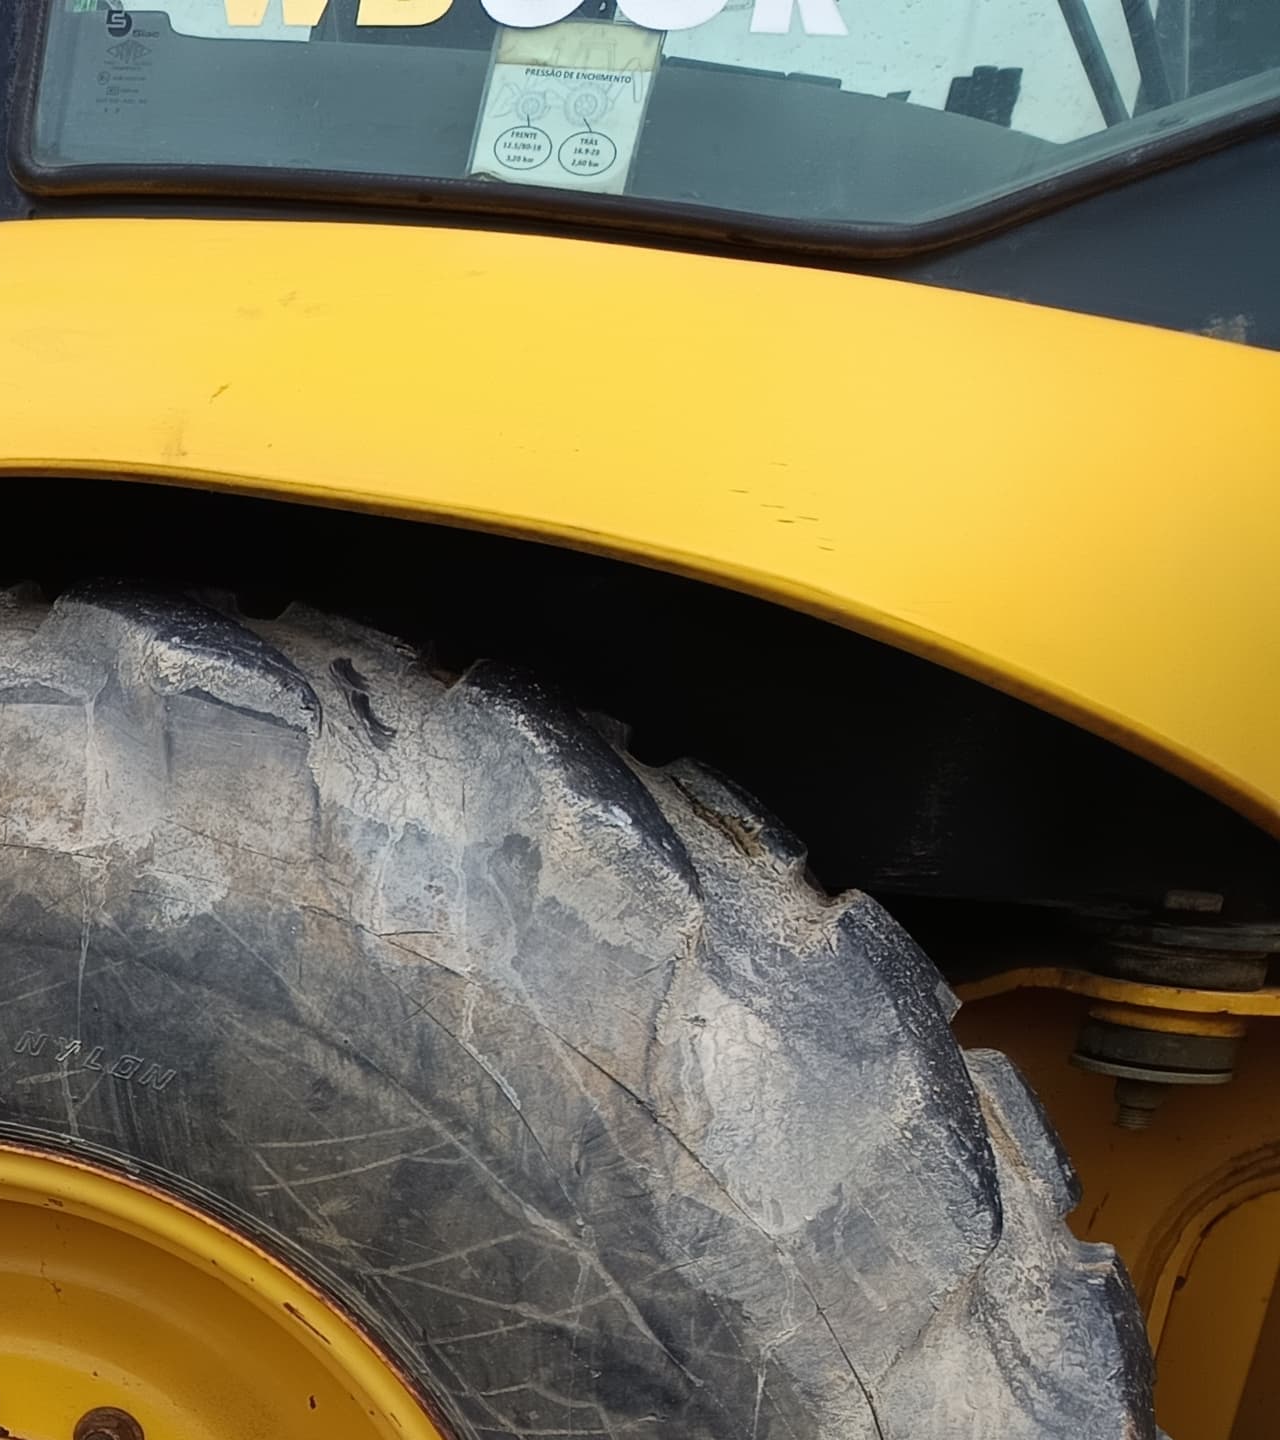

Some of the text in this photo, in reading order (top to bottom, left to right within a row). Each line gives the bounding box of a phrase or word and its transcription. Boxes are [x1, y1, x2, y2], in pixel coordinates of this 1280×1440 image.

[525, 66, 632, 84] PRESSÃO DE ENCHIMENTO
[510, 131, 538, 140] FRENTE
[13, 1030, 177, 1091] NYLON
